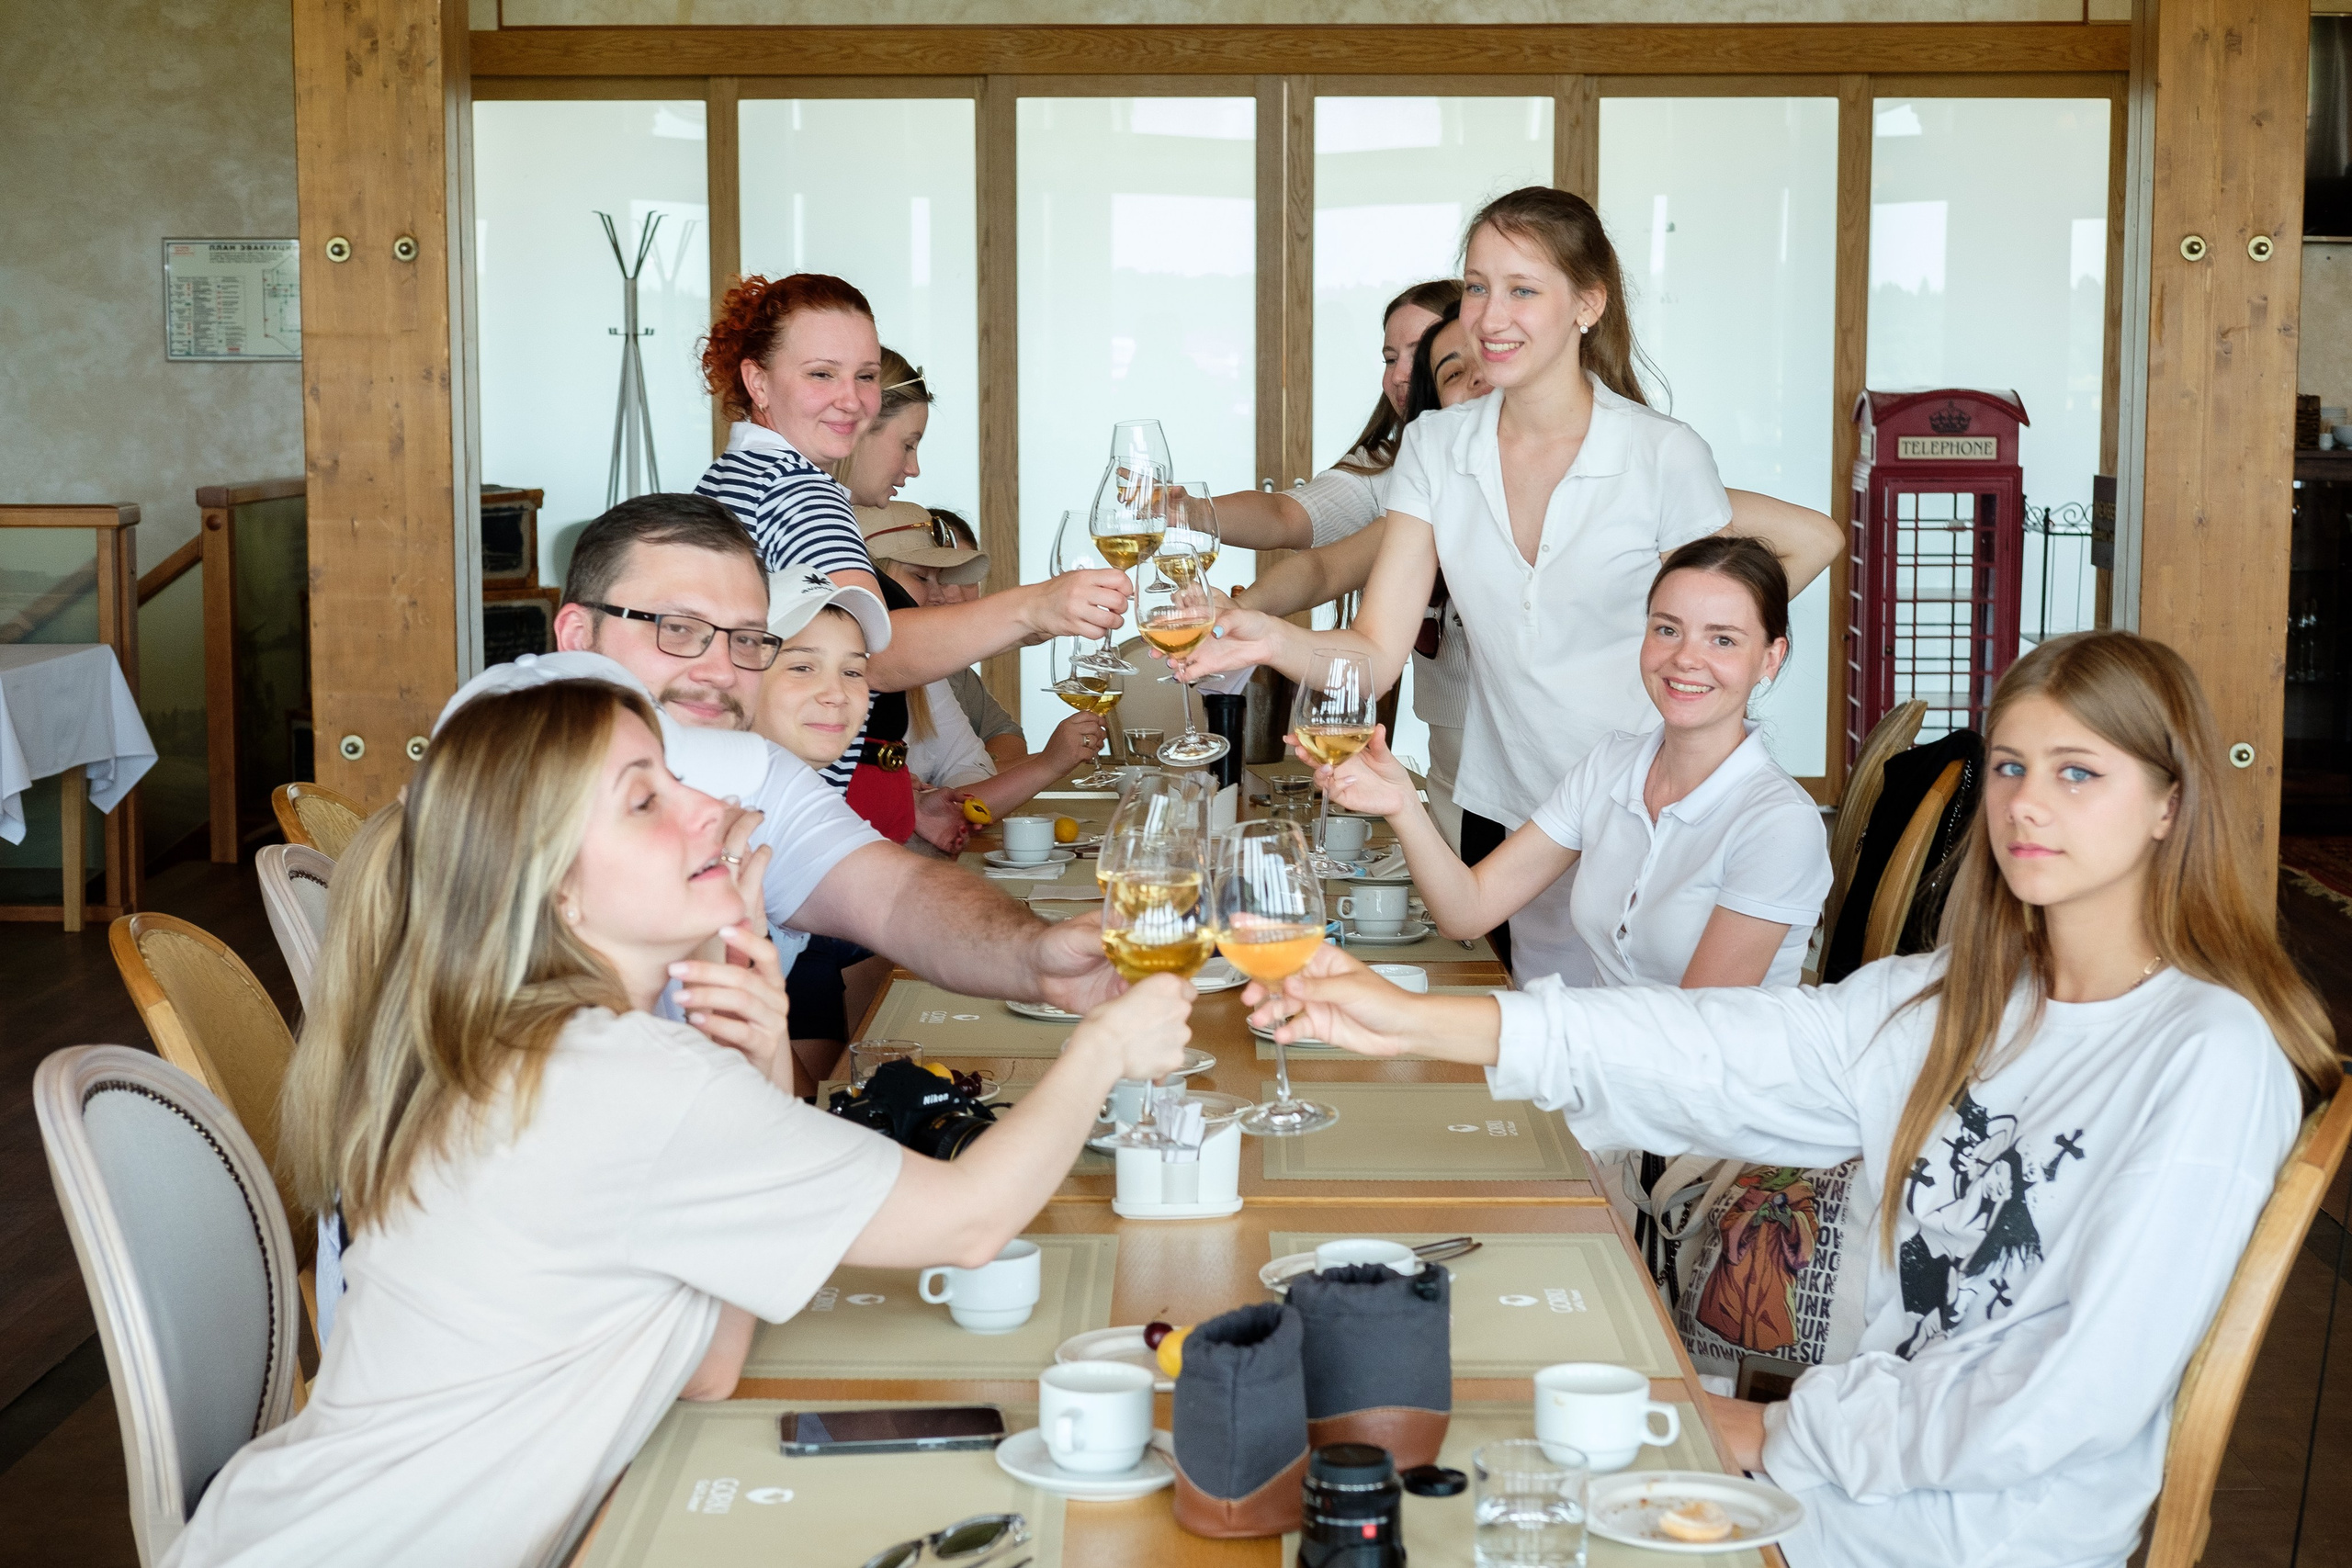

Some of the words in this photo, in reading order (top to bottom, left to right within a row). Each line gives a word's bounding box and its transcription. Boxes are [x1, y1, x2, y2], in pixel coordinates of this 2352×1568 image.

[1902, 441, 1993, 456] TELEPHONE
[922, 1092, 950, 1106] Nikon
[1807, 1177, 1846, 1203] WN
[1683, 1336, 1746, 1363] KNOWN
